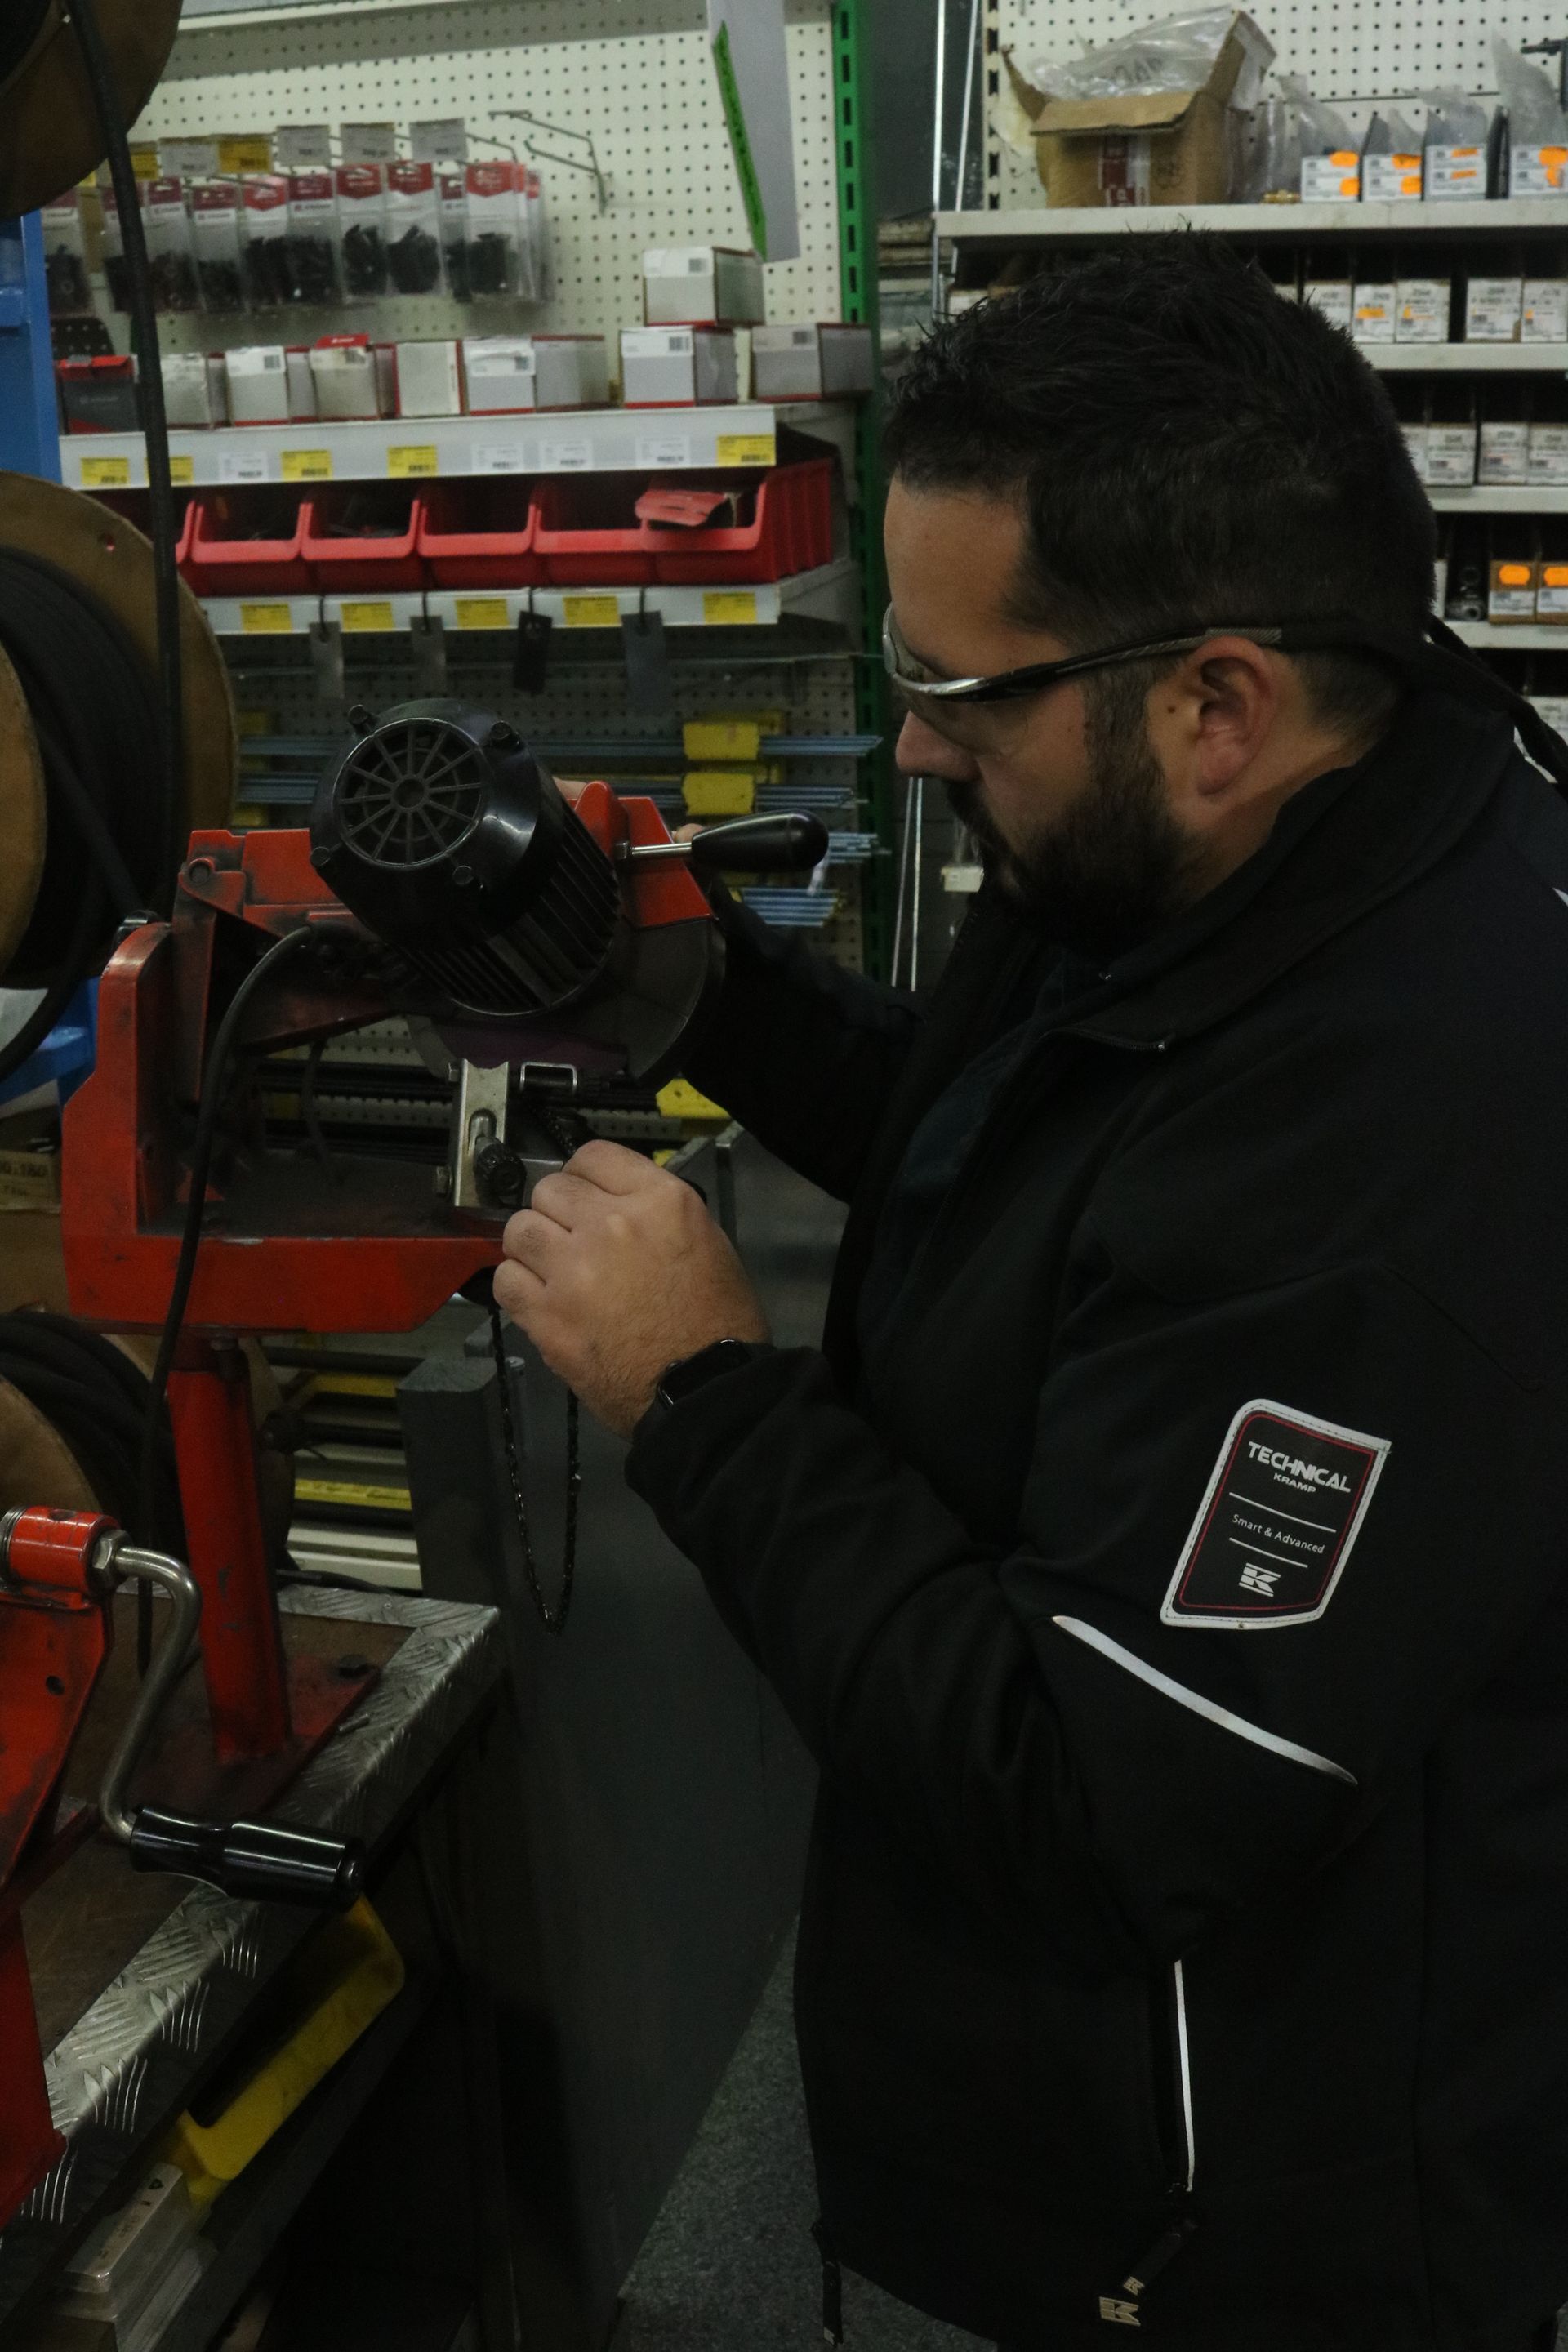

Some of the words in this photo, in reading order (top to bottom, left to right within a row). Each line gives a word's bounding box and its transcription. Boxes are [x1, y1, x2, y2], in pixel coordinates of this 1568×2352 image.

[1248, 1441, 1352, 1494] TECHNICAL
[1273, 1472, 1316, 1494] KRAMP
[1232, 1513, 1262, 1535] Smart
[1263, 1526, 1273, 1538] &
[1274, 1530, 1325, 1555] Advanced
